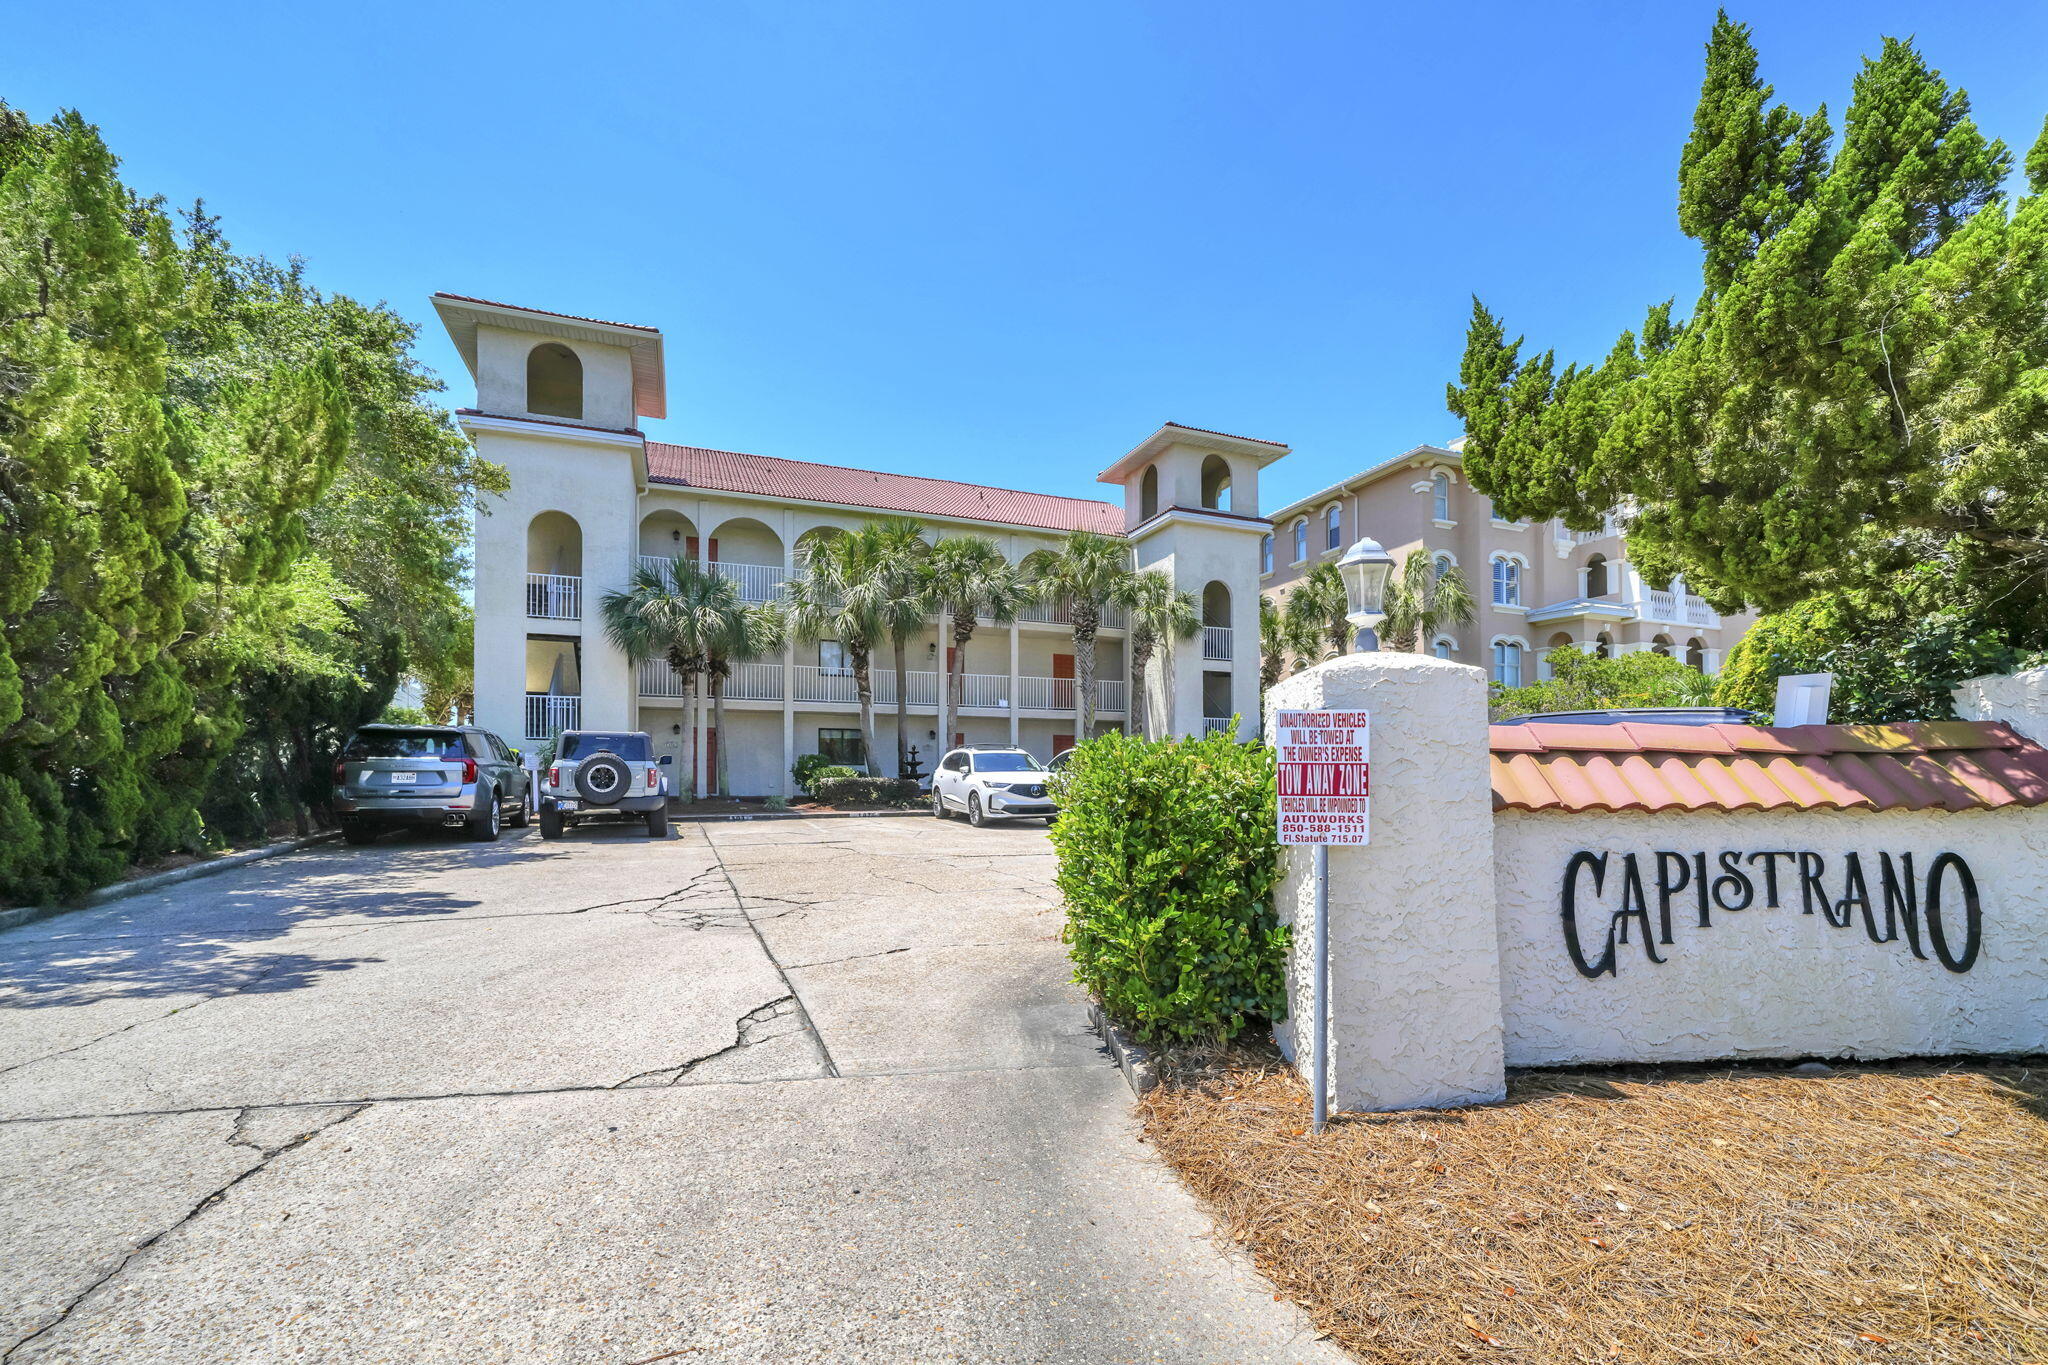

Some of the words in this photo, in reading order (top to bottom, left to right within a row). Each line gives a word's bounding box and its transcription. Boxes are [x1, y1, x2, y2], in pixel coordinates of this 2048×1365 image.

[1280, 713, 1330, 727] UNAUTHORIZED
[1333, 713, 1366, 727] VEHICLES
[1291, 730, 1307, 744] WILL
[1309, 730, 1318, 744] BE
[1319, 730, 1343, 744] TOWED
[1345, 730, 1354, 744] AT
[1283, 747, 1295, 761] THE
[1298, 747, 1328, 761] OWNER'S
[1331, 747, 1362, 761] EXPENSE
[1280, 765, 1302, 794] TOW
[1306, 765, 1334, 794] AWAY
[1339, 765, 1366, 795] ZONE
[1281, 798, 1305, 812] VEHICLES
[1306, 798, 1317, 813] WILL
[1320, 798, 1326, 813] BE
[1328, 798, 1357, 813] IMPOUNDED
[1360, 798, 1365, 813] TO
[1283, 815, 1364, 824] AUTOWORKS
[1282, 824, 1365, 833] 850-588-1511
[1331, 834, 1363, 843] 715.07
[1560, 850, 1982, 978] CAPISTRANO
